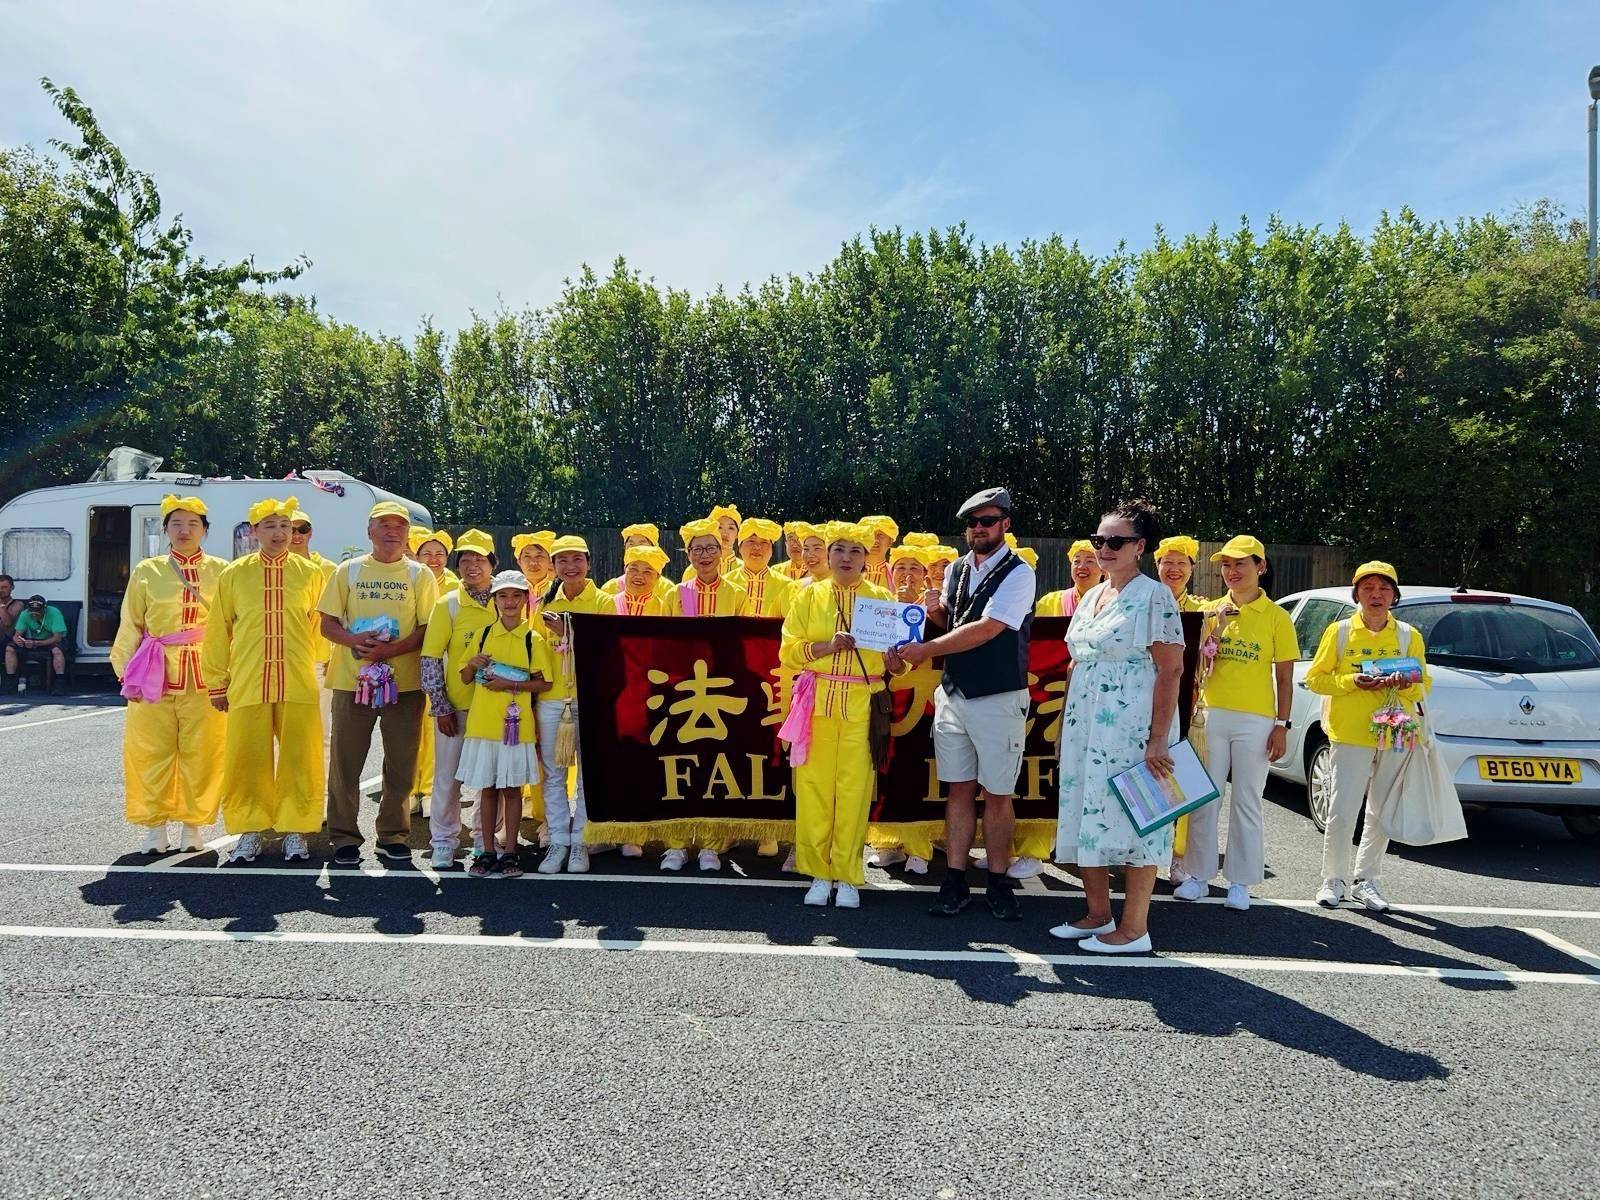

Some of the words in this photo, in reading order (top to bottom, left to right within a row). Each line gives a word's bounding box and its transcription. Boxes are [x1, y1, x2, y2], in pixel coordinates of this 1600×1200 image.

[356, 581, 382, 590] FALUN
[383, 581, 409, 591] GONG
[357, 591, 407, 601] 法輪大法
[1217, 646, 1234, 656] LUN
[1235, 648, 1260, 661] DAFA
[1486, 760, 1535, 778] BT60
[1538, 761, 1575, 779] YVA
